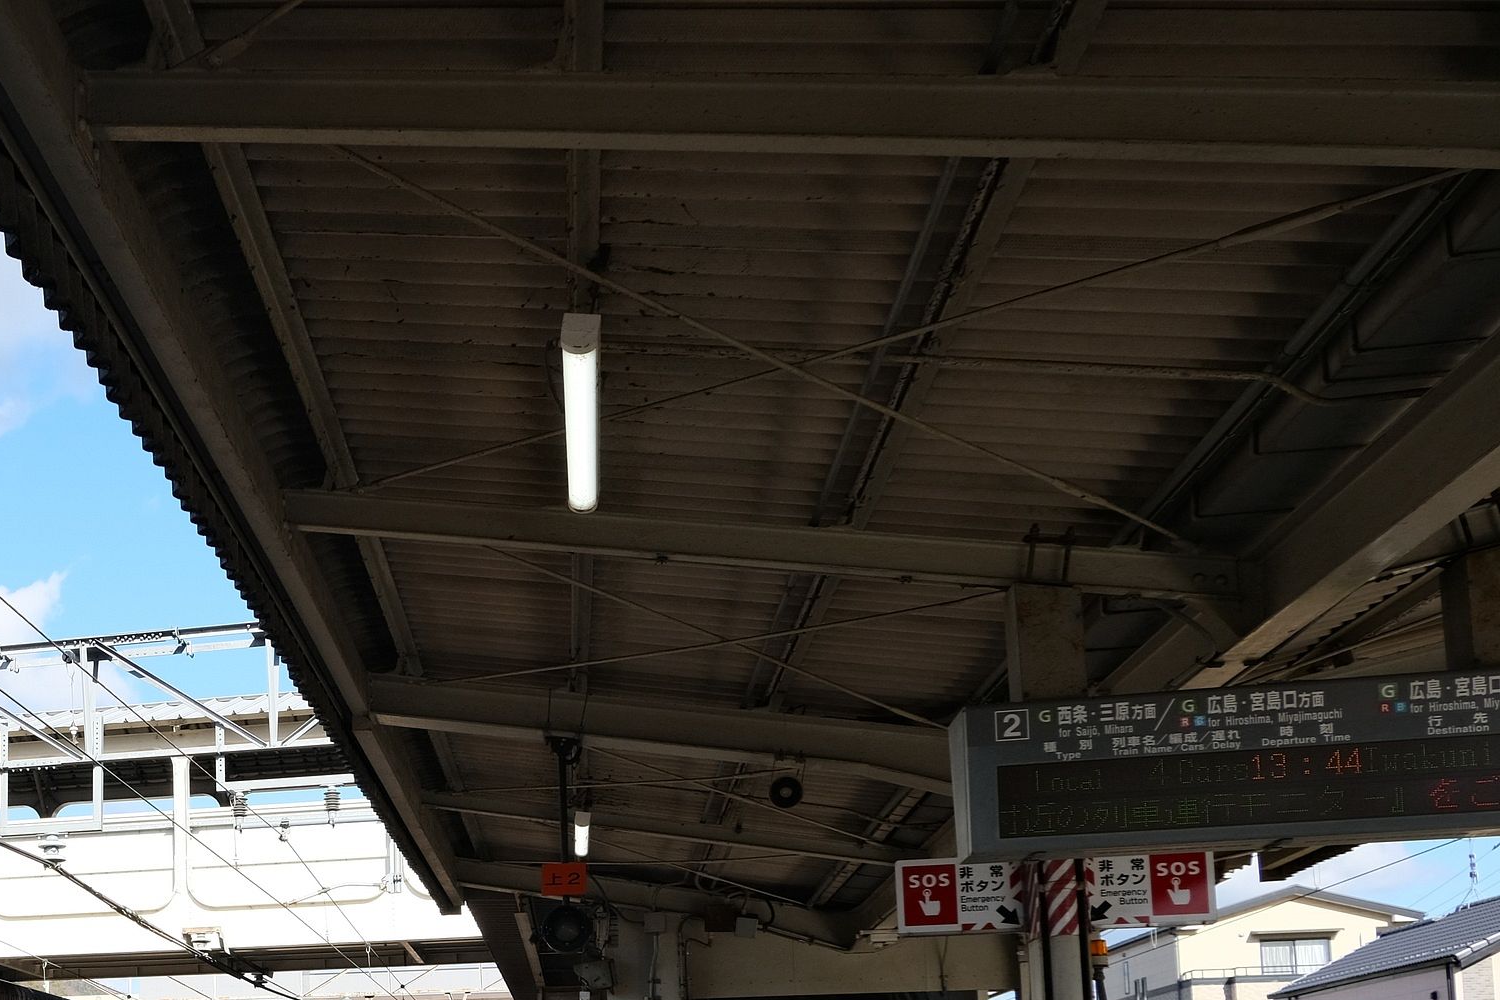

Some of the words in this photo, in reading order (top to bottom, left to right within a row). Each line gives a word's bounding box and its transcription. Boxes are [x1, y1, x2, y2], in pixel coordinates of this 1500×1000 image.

[1381, 684, 1396, 698] G
[1182, 699, 1195, 713] G
[1207, 690, 1325, 715] 広島・宮島口方面
[1410, 702, 1424, 713] for
[1428, 700, 1479, 712] Hiroshima,
[1038, 709, 1051, 723] G
[1057, 701, 1157, 725] 西条・三原方面
[1208, 717, 1221, 728] for
[1225, 714, 1274, 726] Hiroshima,
[1278, 708, 1343, 724] Miyajimaguchi
[1003, 713, 1021, 738] 2
[1059, 727, 1071, 738] for
[1104, 723, 1134, 736] Mihara
[1427, 724, 1490, 735] Destination
[1261, 735, 1317, 748] Departure
[1323, 734, 1351, 743] Time
[1055, 751, 1081, 761] Type
[1112, 747, 1139, 756] Train
[1156, 860, 1201, 877] SOS
[908, 873, 950, 889] SOS
[1100, 873, 1146, 886] ボタン
[960, 880, 1005, 893] ボタン
[1100, 888, 1148, 898] Emergency
[960, 895, 1006, 904] Emergency
[1119, 896, 1149, 905] Button
[961, 904, 989, 913] Button
